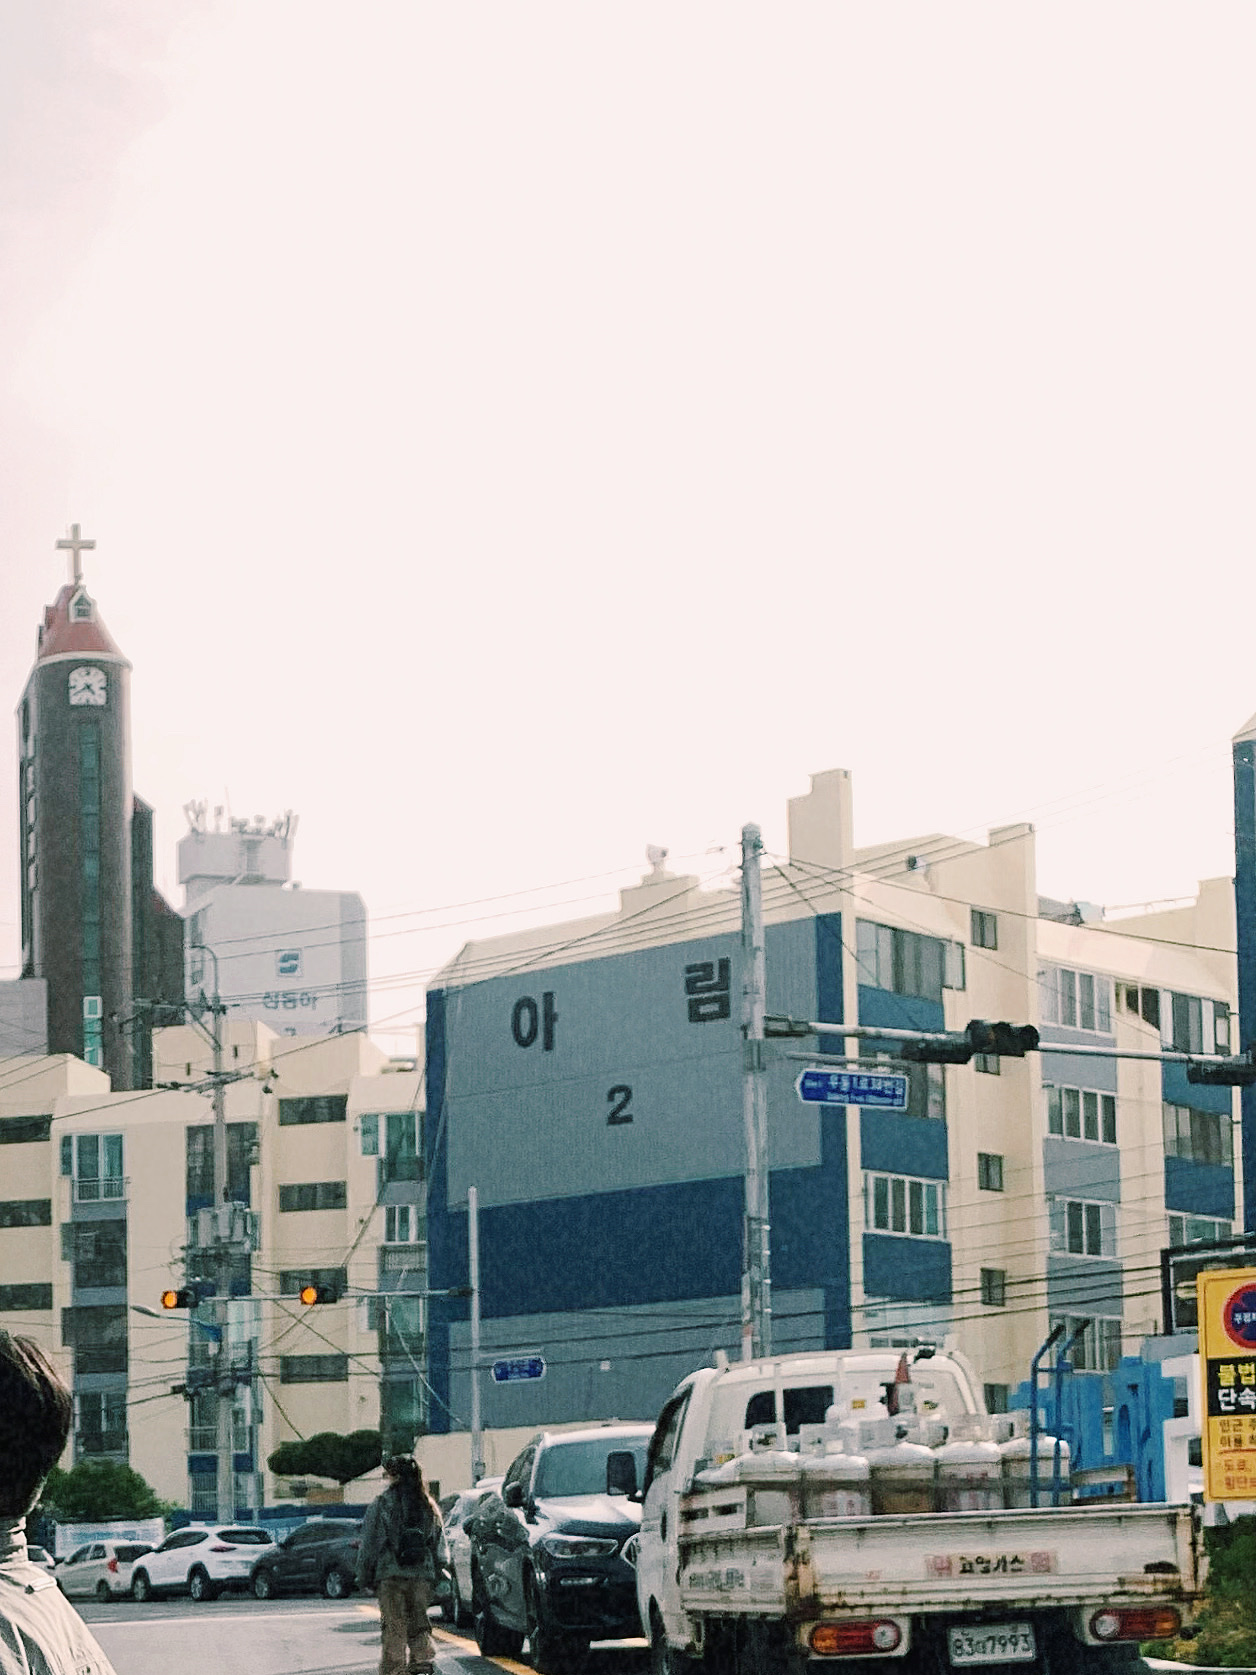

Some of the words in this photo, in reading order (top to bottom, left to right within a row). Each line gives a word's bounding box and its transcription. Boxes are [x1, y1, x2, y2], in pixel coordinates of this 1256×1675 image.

[607, 1084, 634, 1126] 2
[1218, 1363, 1255, 1387] 불법
[1218, 1387, 1256, 1412] 단속
